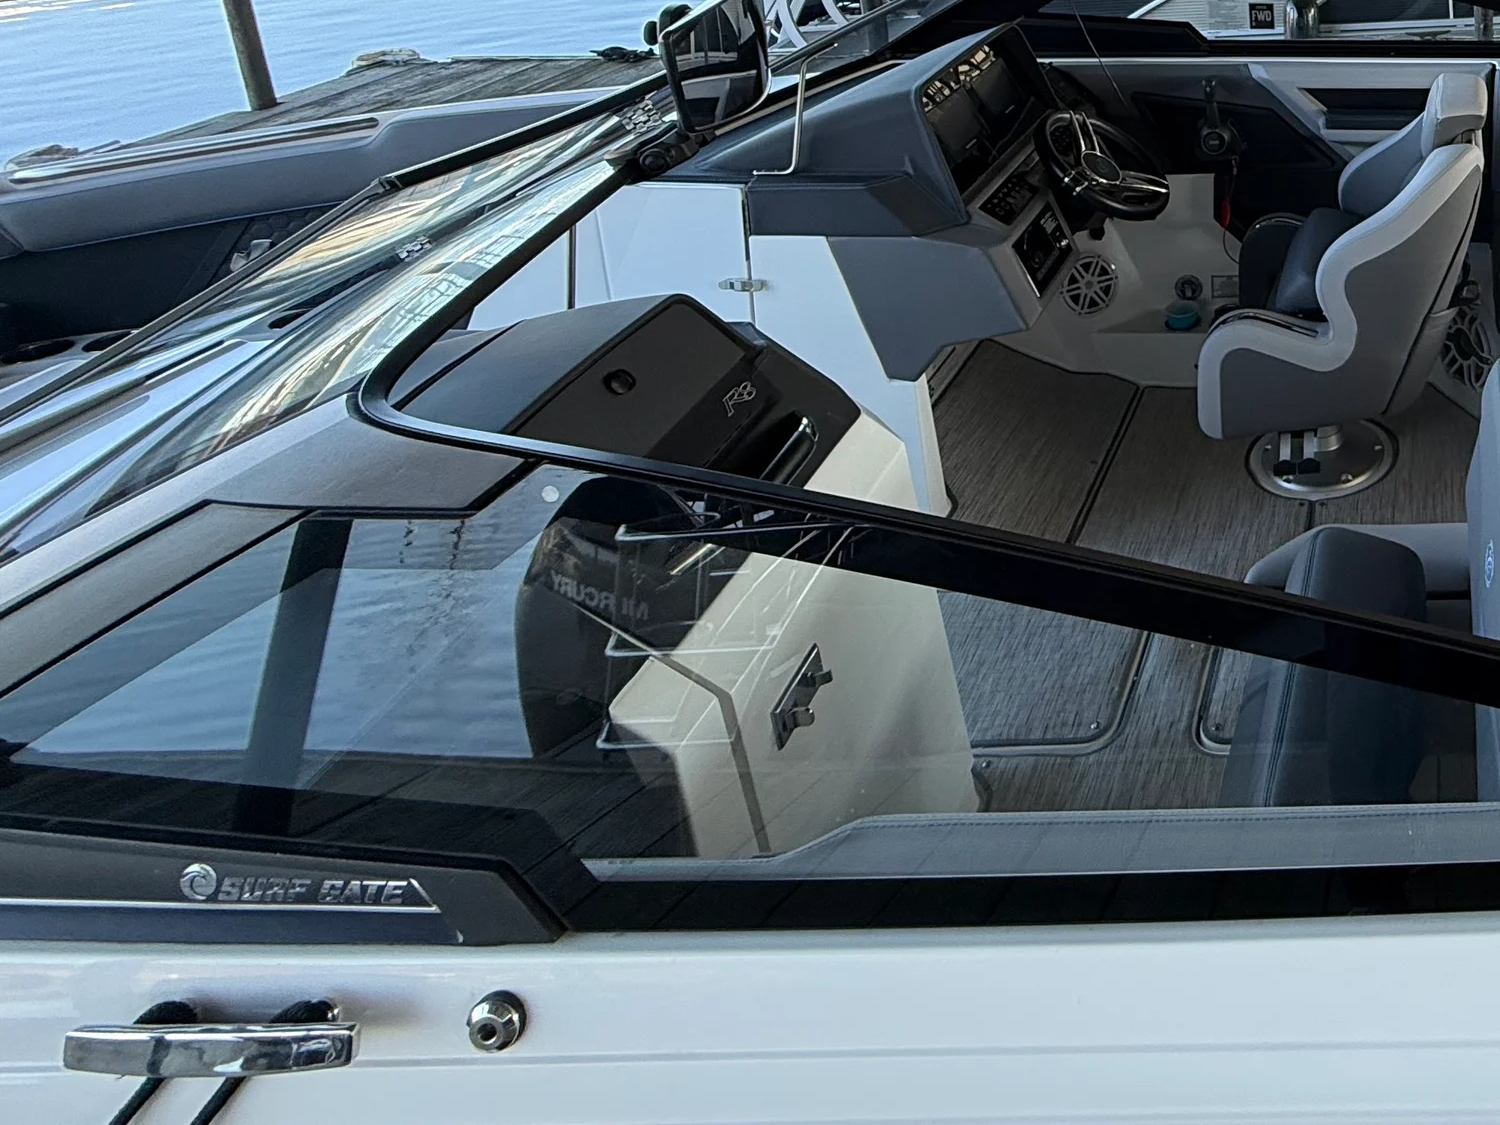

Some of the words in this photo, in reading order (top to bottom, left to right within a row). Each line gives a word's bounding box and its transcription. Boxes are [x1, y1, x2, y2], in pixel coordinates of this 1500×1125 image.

[1251, 10, 1272, 22] FWD
[217, 876, 312, 902] SURF
[317, 879, 408, 904] GATE
